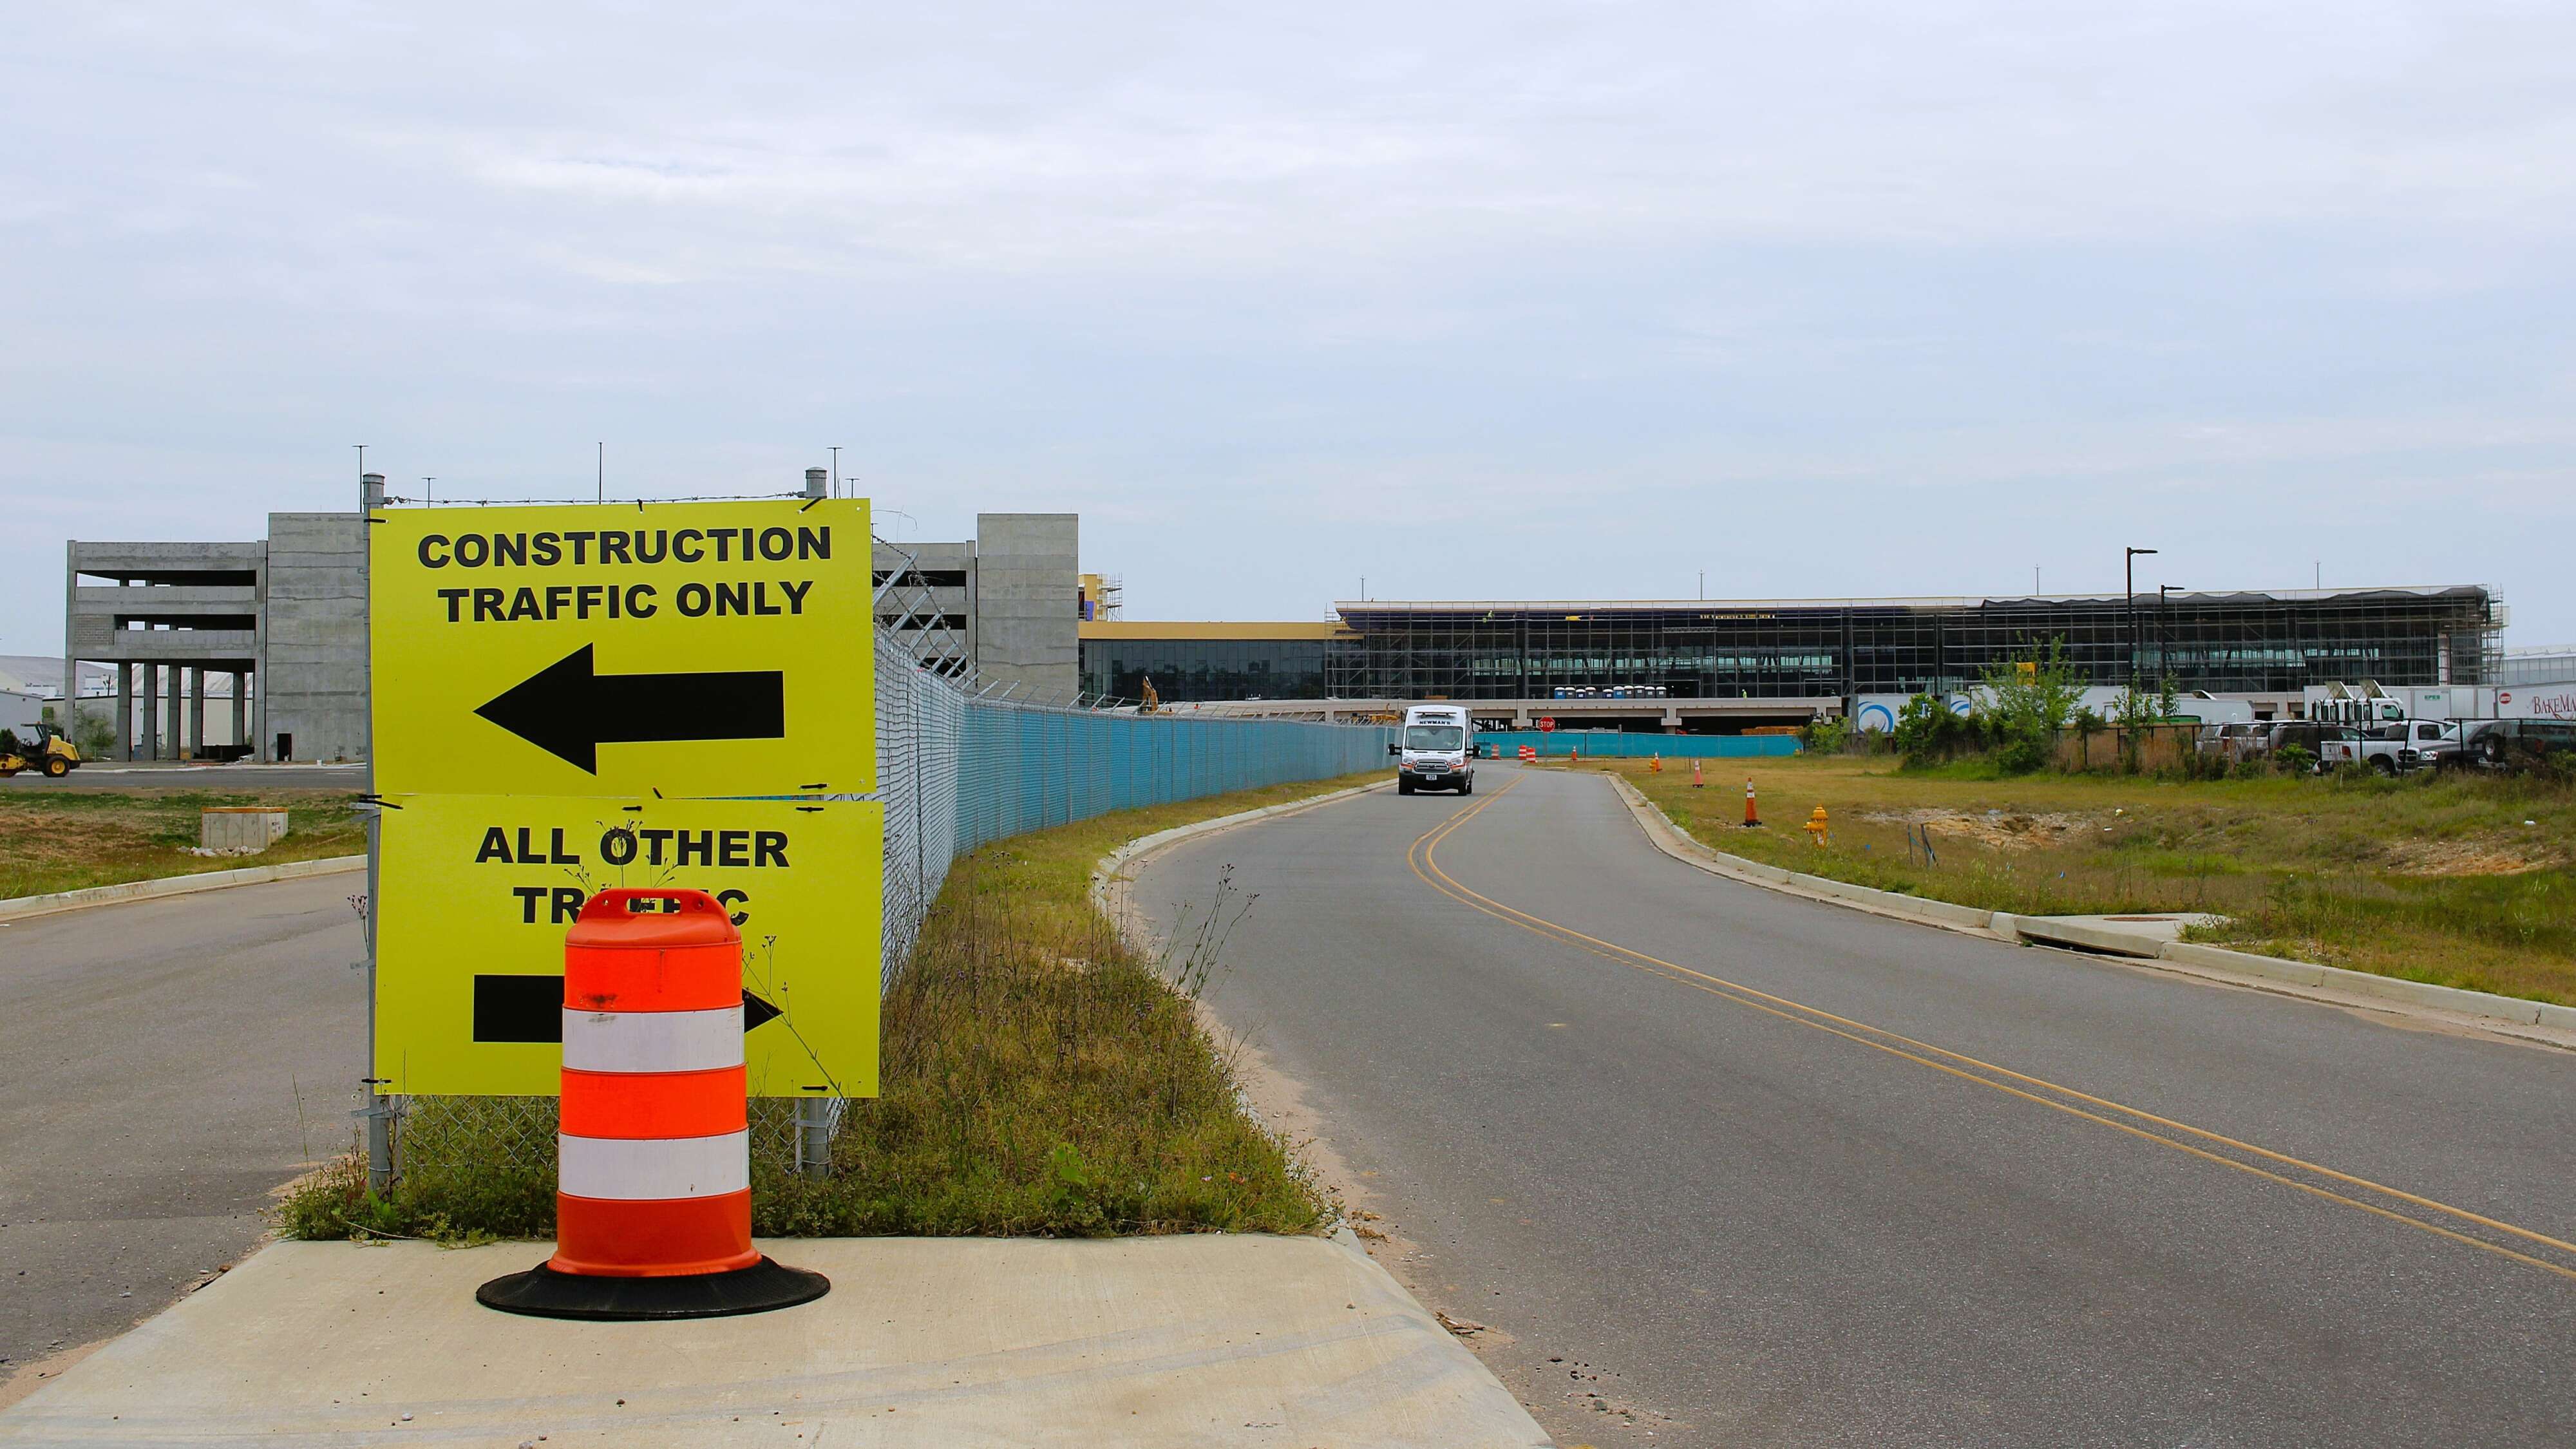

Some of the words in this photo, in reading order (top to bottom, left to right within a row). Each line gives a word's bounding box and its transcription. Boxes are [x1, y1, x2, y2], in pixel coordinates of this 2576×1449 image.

[417, 526, 831, 569] CONSTRUCTION
[437, 583, 658, 623] TRAFFIC
[676, 580, 814, 618] ONLY
[475, 826, 580, 866] ALL
[600, 828, 791, 868] OTHER
